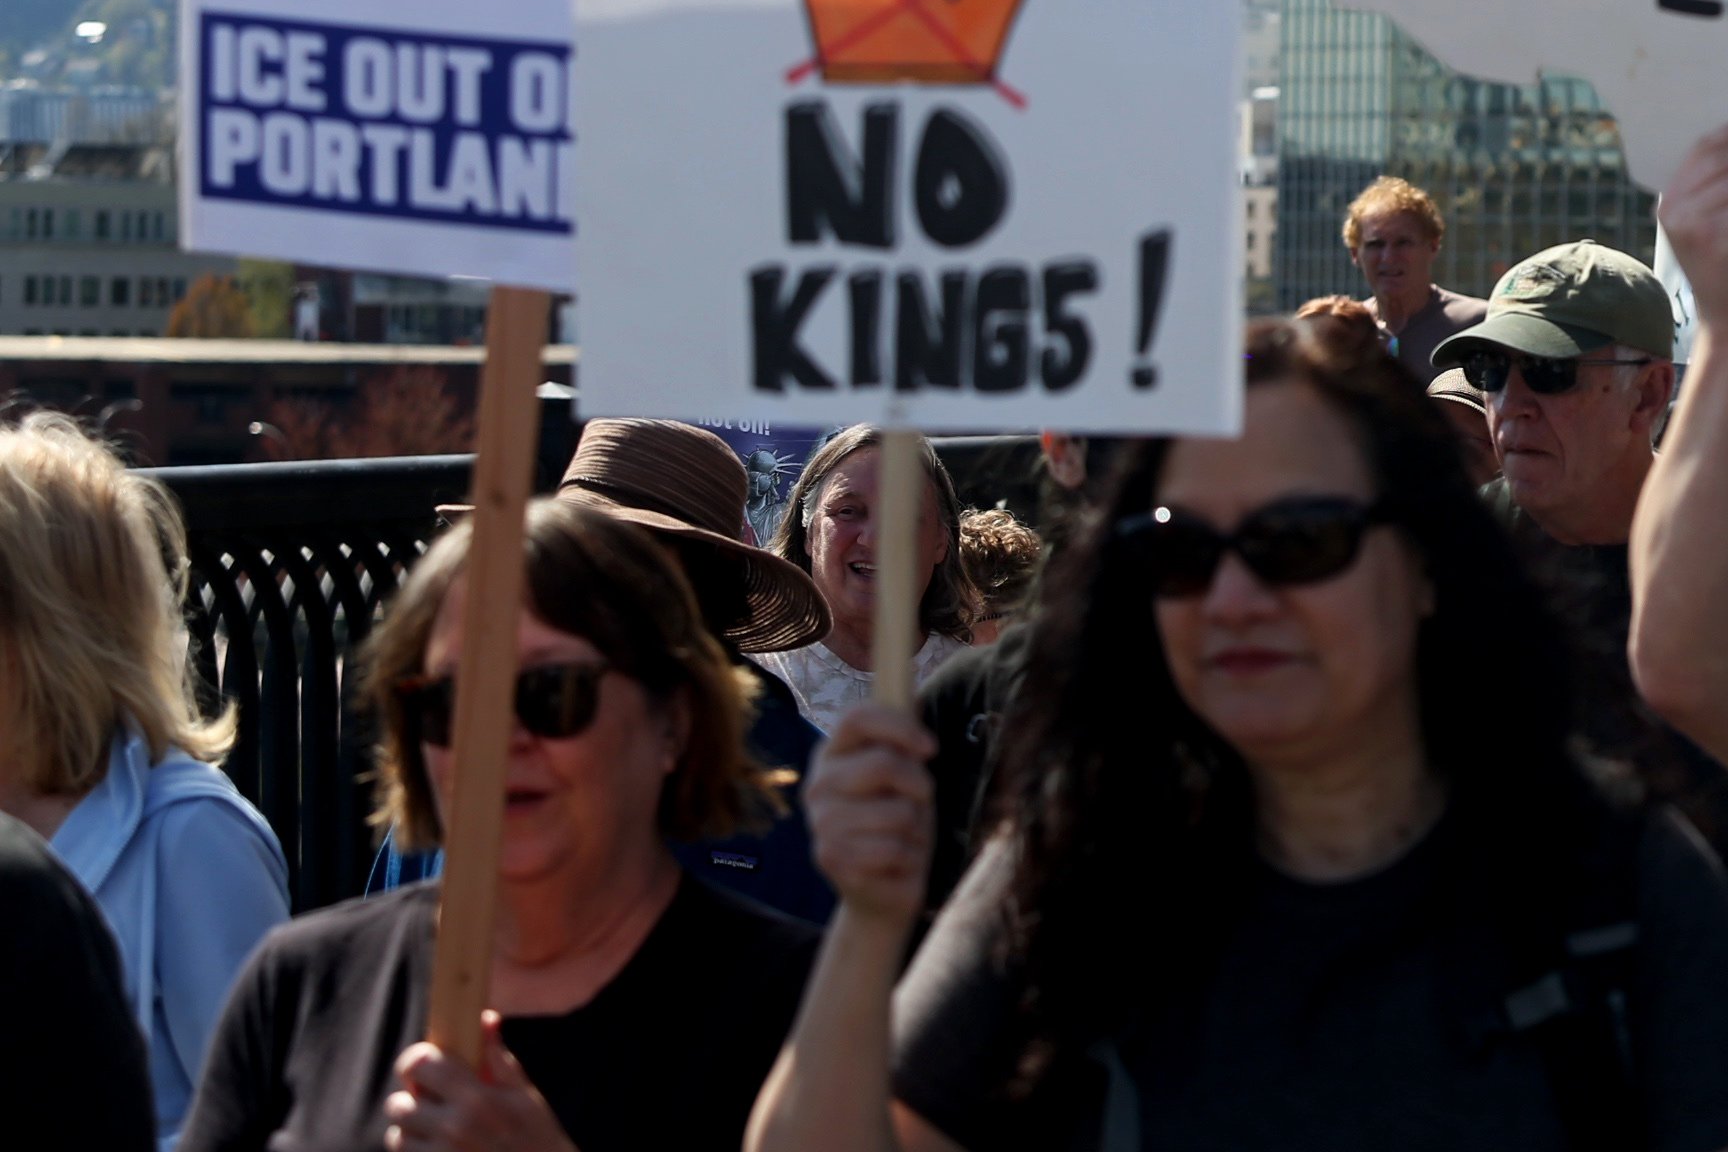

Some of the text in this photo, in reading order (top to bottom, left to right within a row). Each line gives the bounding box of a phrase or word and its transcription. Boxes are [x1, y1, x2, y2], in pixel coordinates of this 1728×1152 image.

[210, 24, 575, 135] ICE OUT O
[783, 97, 1014, 251] NO
